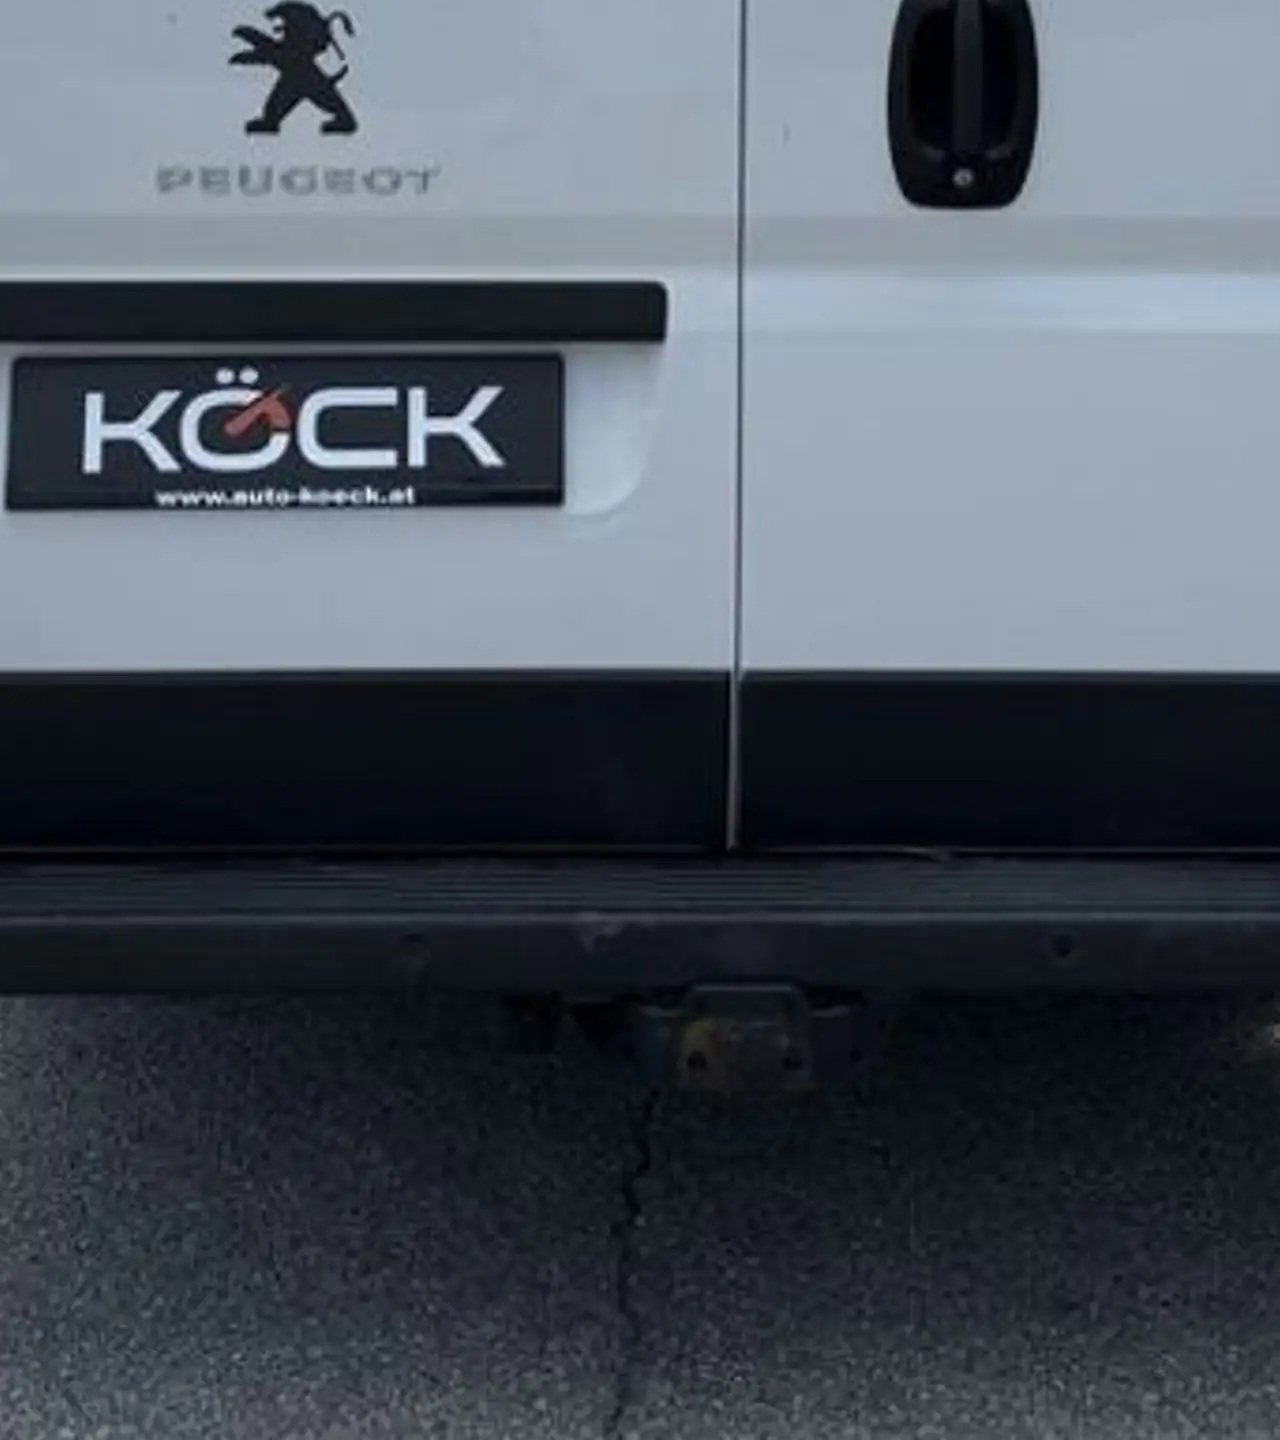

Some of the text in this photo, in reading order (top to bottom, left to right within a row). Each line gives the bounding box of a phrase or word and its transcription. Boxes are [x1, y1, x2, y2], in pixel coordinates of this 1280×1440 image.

[156, 164, 440, 197] PEUGEOT
[82, 367, 506, 474] KÖCK
[154, 485, 417, 507] www.auto-koeck.at
